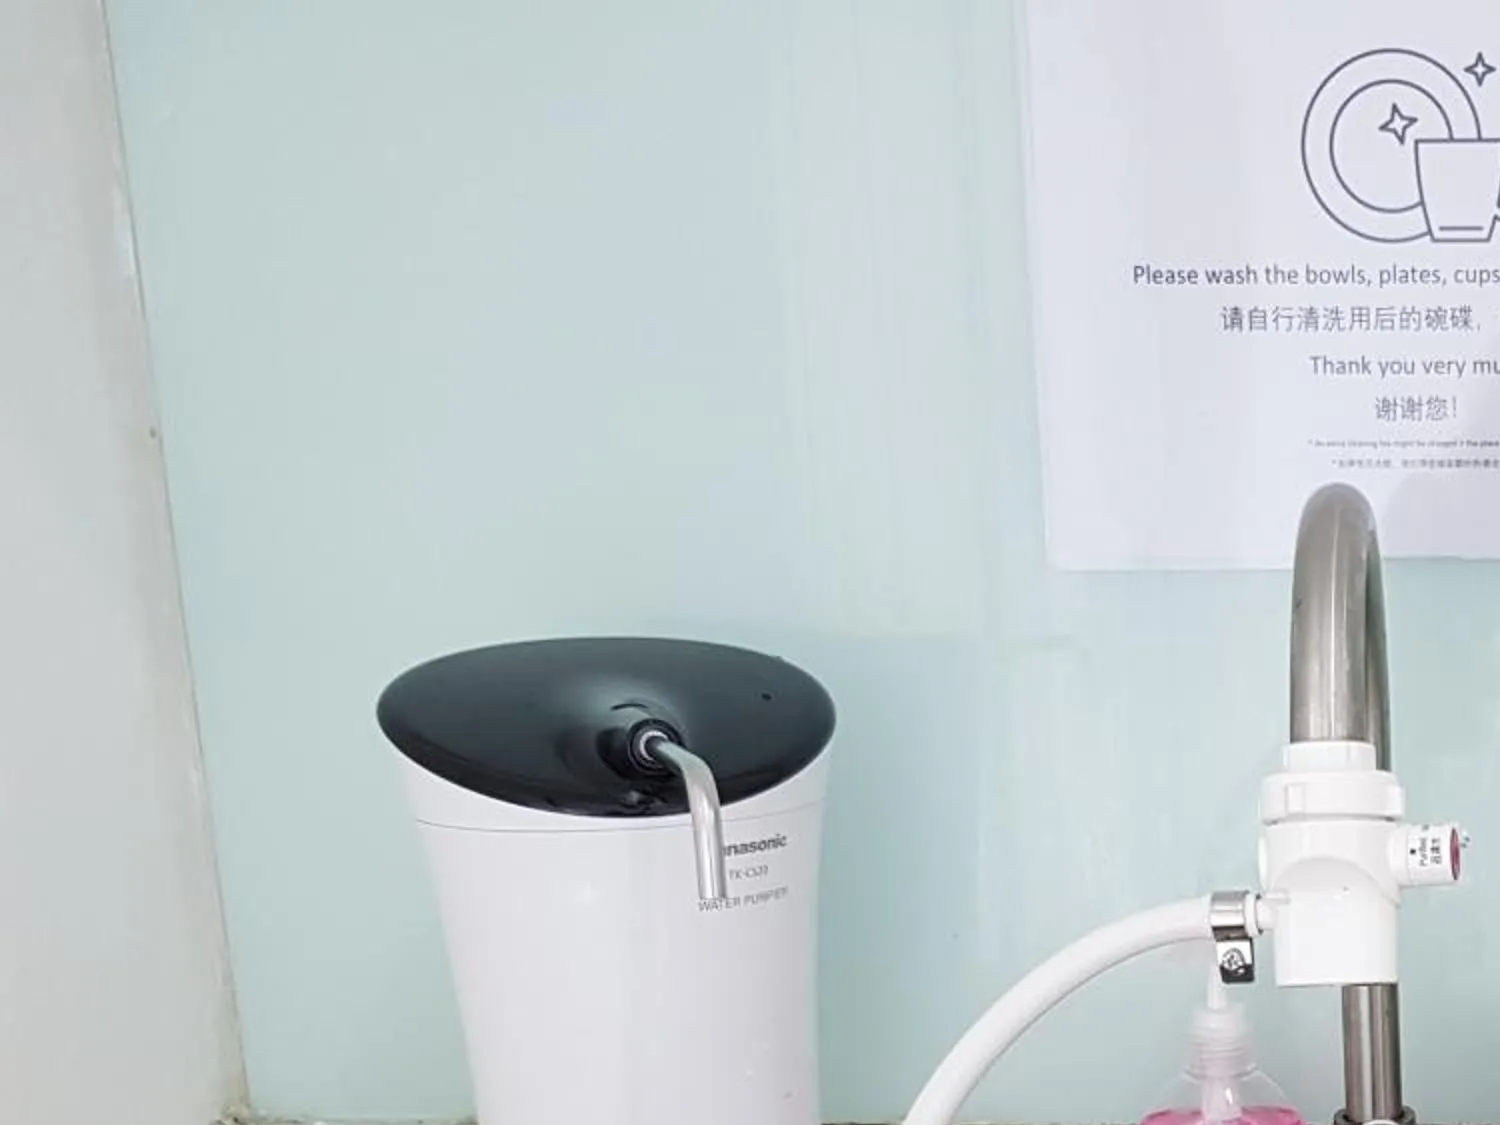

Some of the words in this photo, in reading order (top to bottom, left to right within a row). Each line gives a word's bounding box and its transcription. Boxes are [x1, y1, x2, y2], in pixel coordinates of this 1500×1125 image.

[1132, 264, 1199, 285] Please
[1204, 264, 1259, 285] wash
[1265, 264, 1300, 285] the
[1304, 263, 1373, 287] bowls,
[1378, 263, 1448, 288] plates,
[1308, 353, 1372, 376] Thank
[1377, 359, 1416, 379] you
[1421, 359, 1467, 379] very
[723, 833, 788, 856] nasonic
